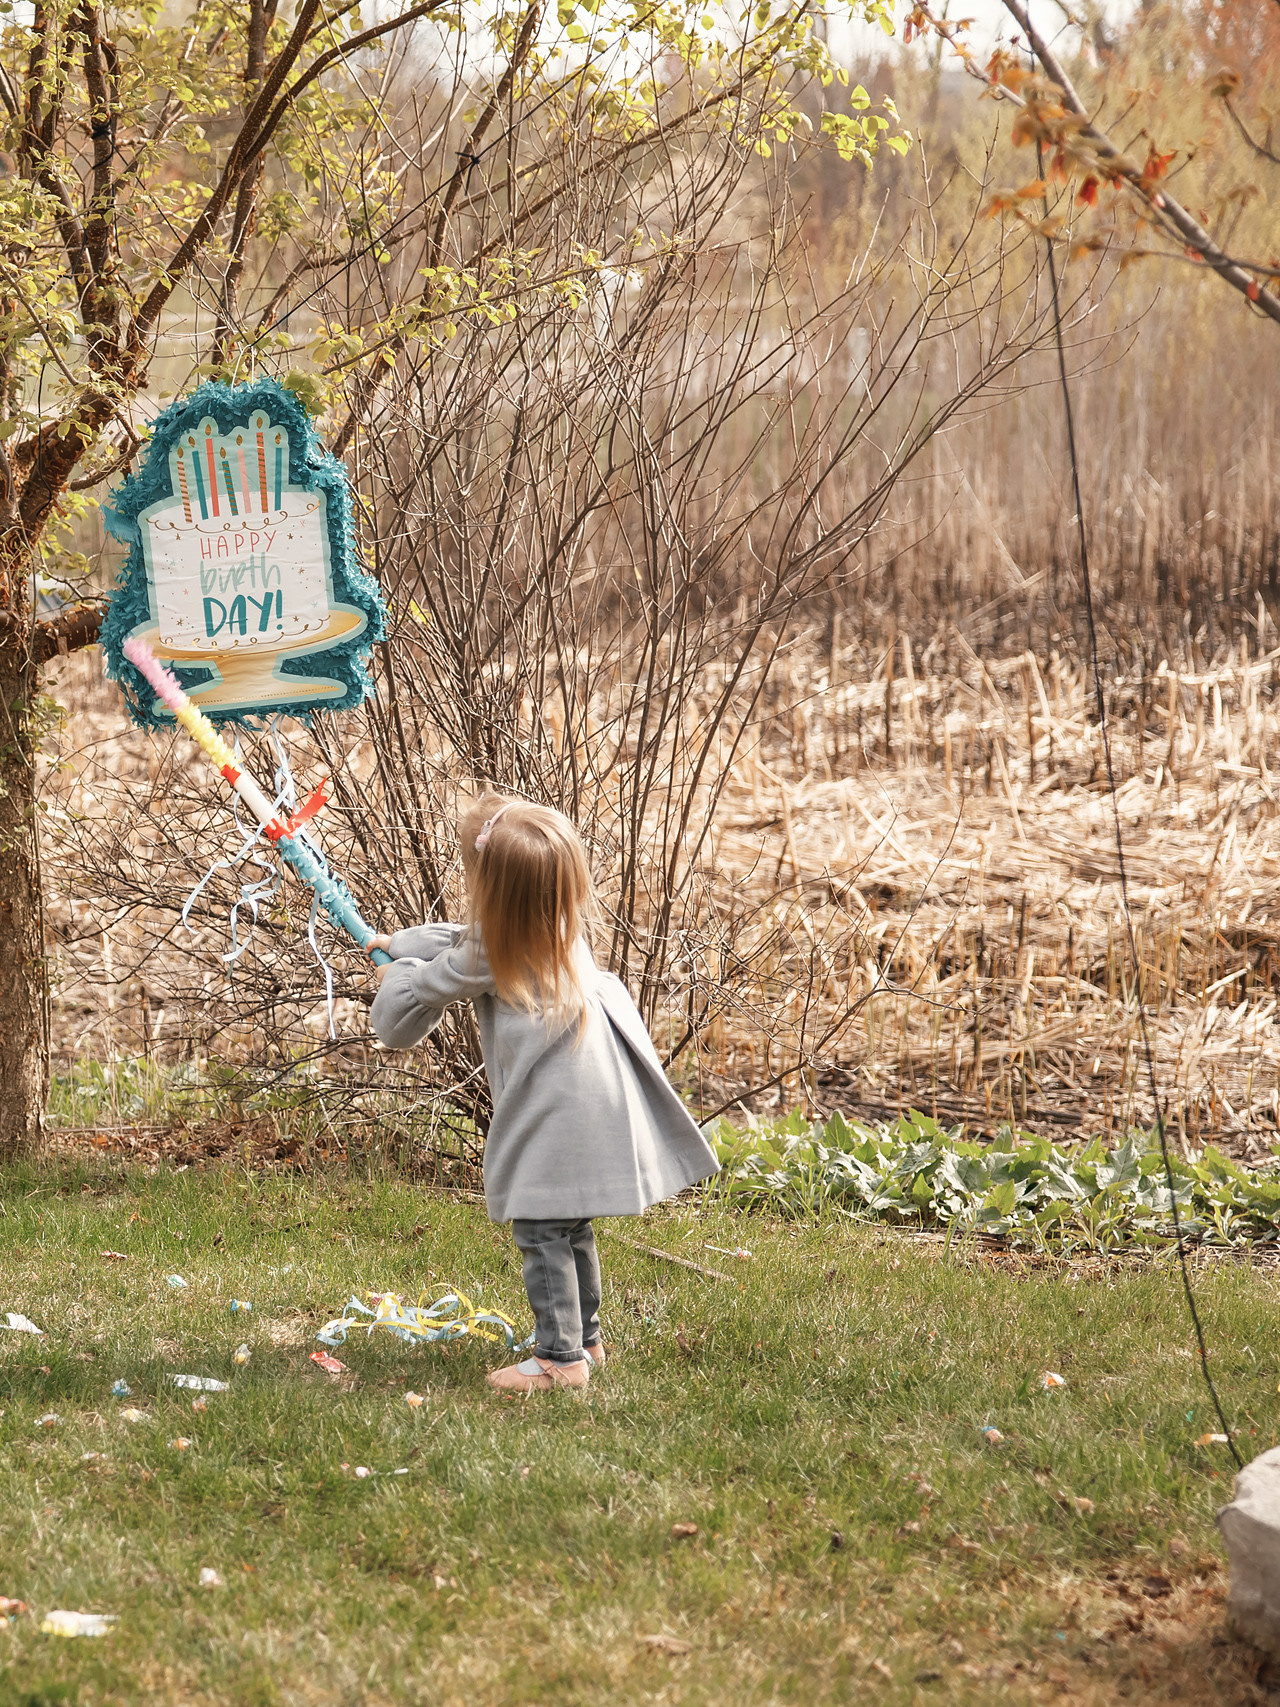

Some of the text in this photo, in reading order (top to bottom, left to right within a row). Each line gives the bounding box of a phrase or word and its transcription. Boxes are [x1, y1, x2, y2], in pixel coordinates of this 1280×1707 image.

[200, 530, 277, 559] HAPPY
[200, 552, 281, 595] birth
[203, 589, 283, 638] DAY!
